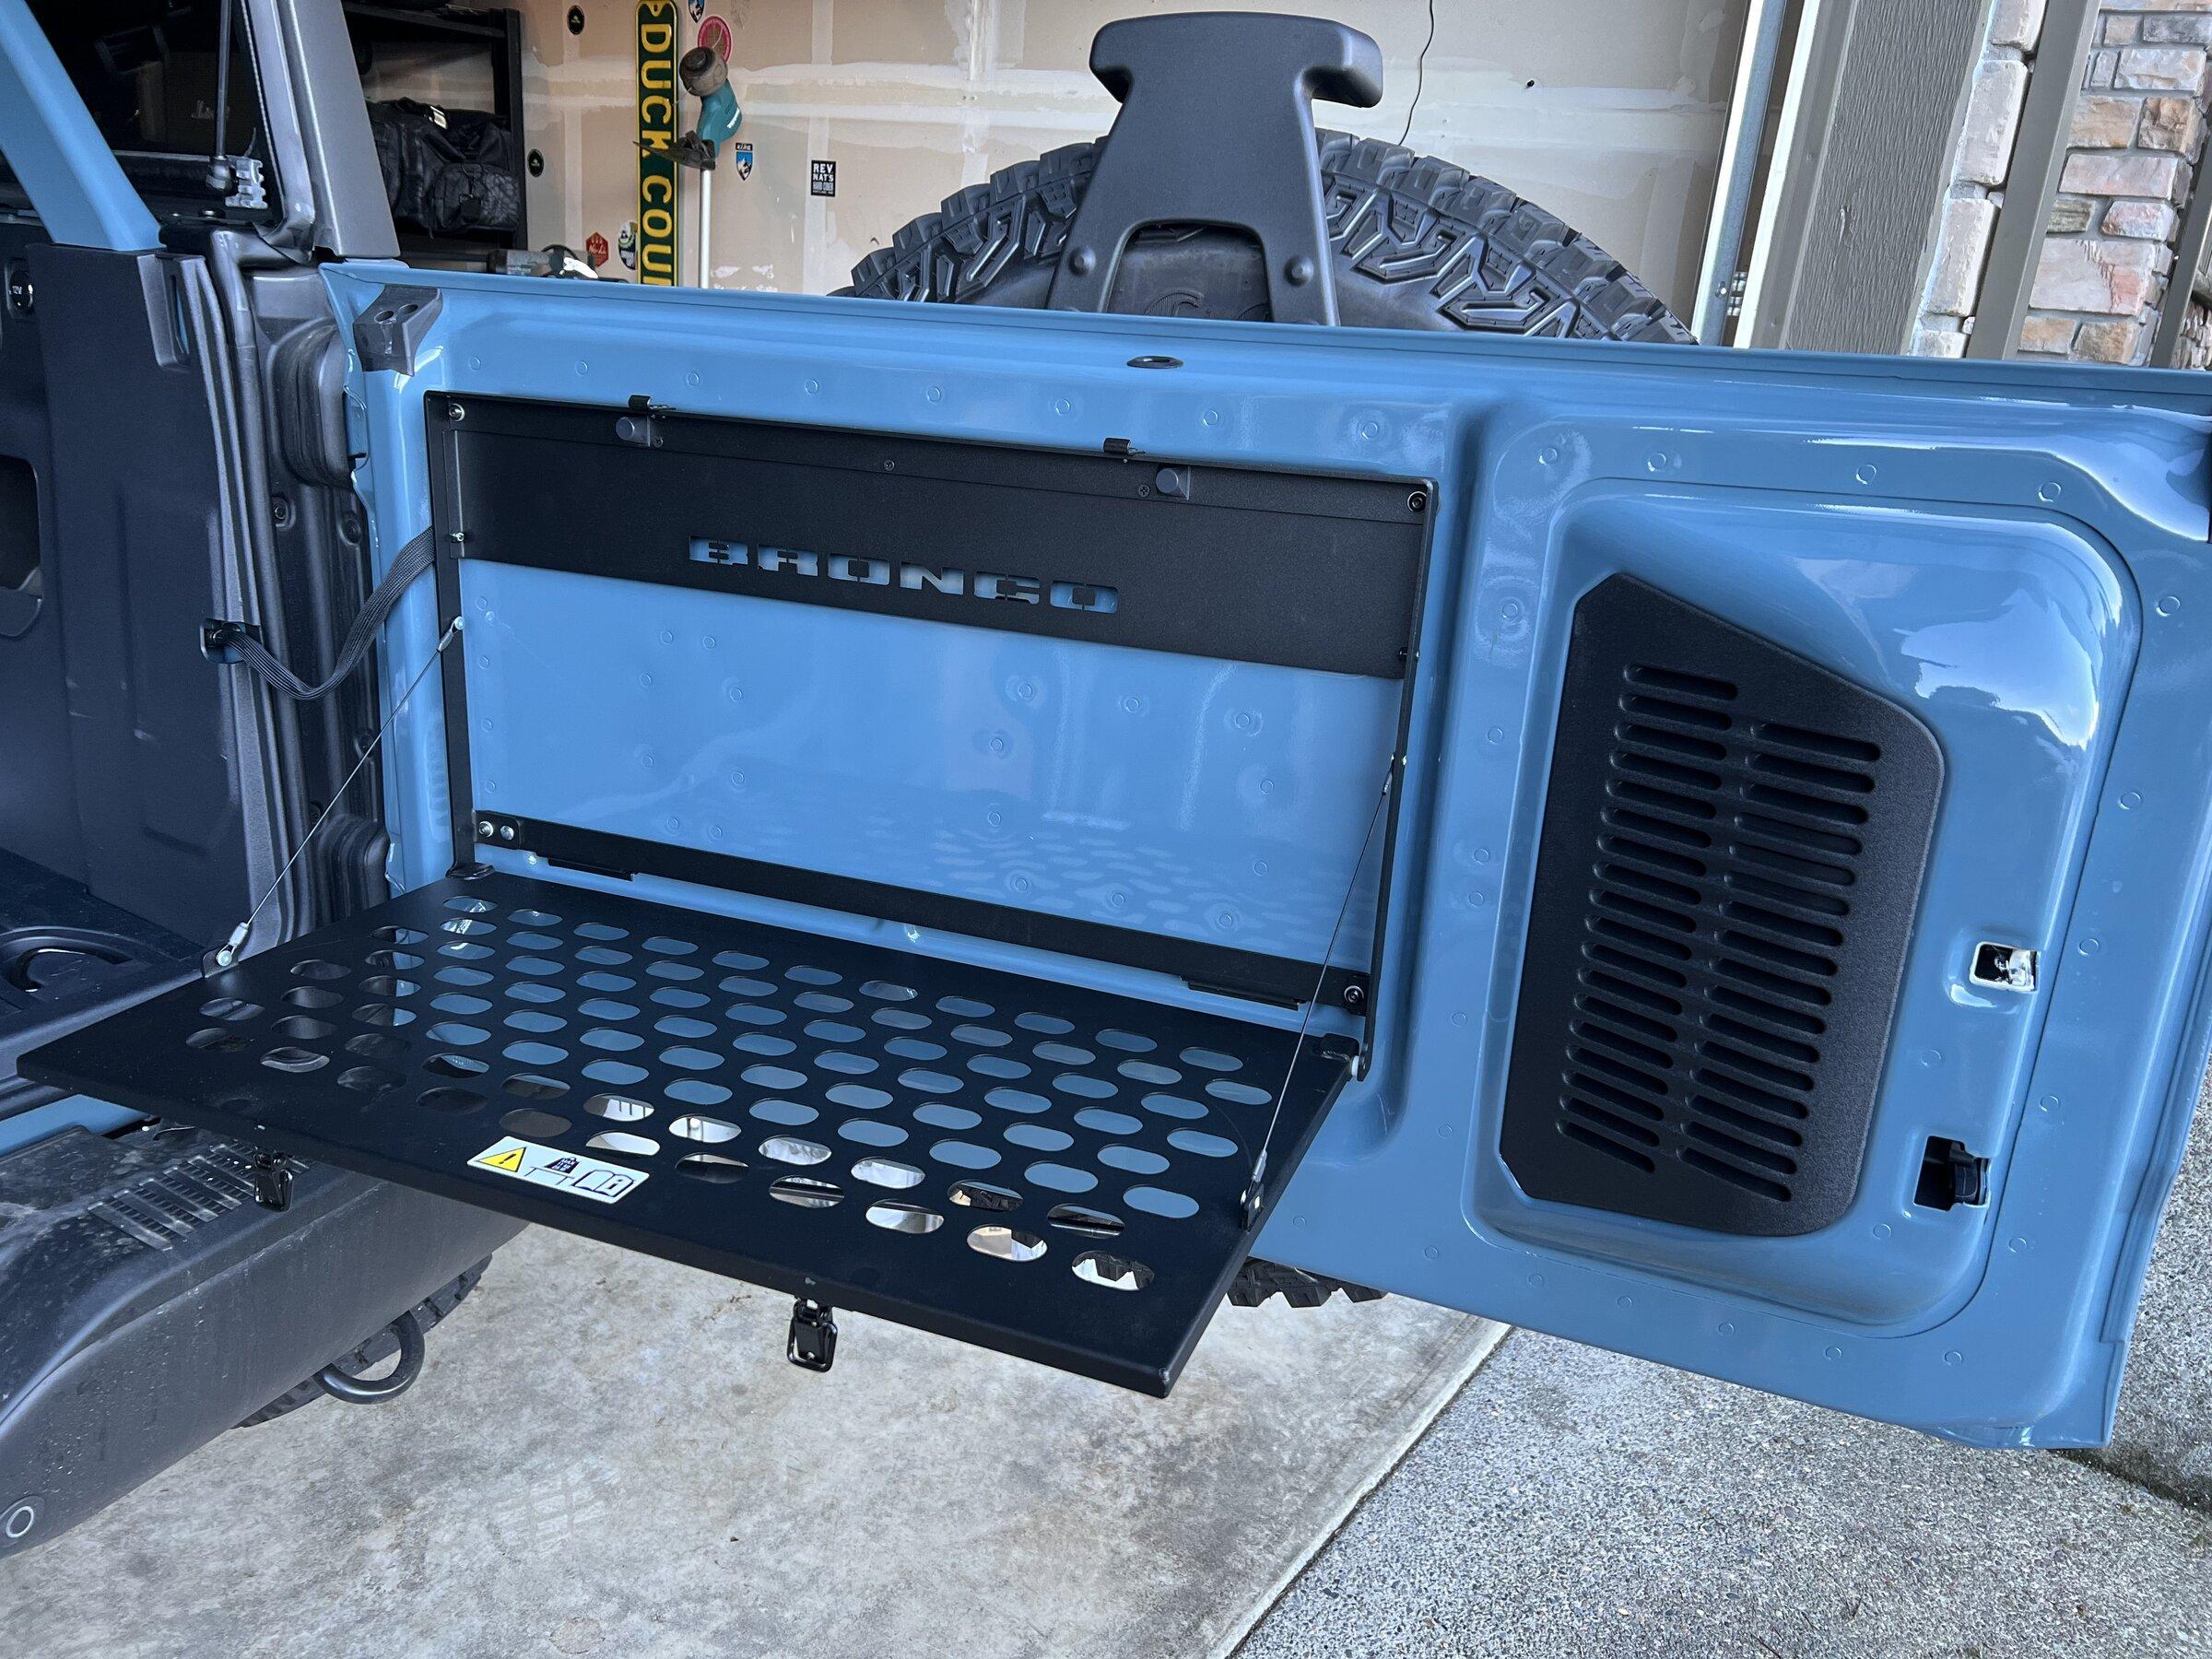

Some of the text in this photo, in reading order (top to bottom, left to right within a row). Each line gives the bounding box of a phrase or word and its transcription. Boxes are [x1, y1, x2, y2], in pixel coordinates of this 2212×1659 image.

[641, 24, 672, 286] DUCK COU
[688, 535, 1119, 615] BRONCO
